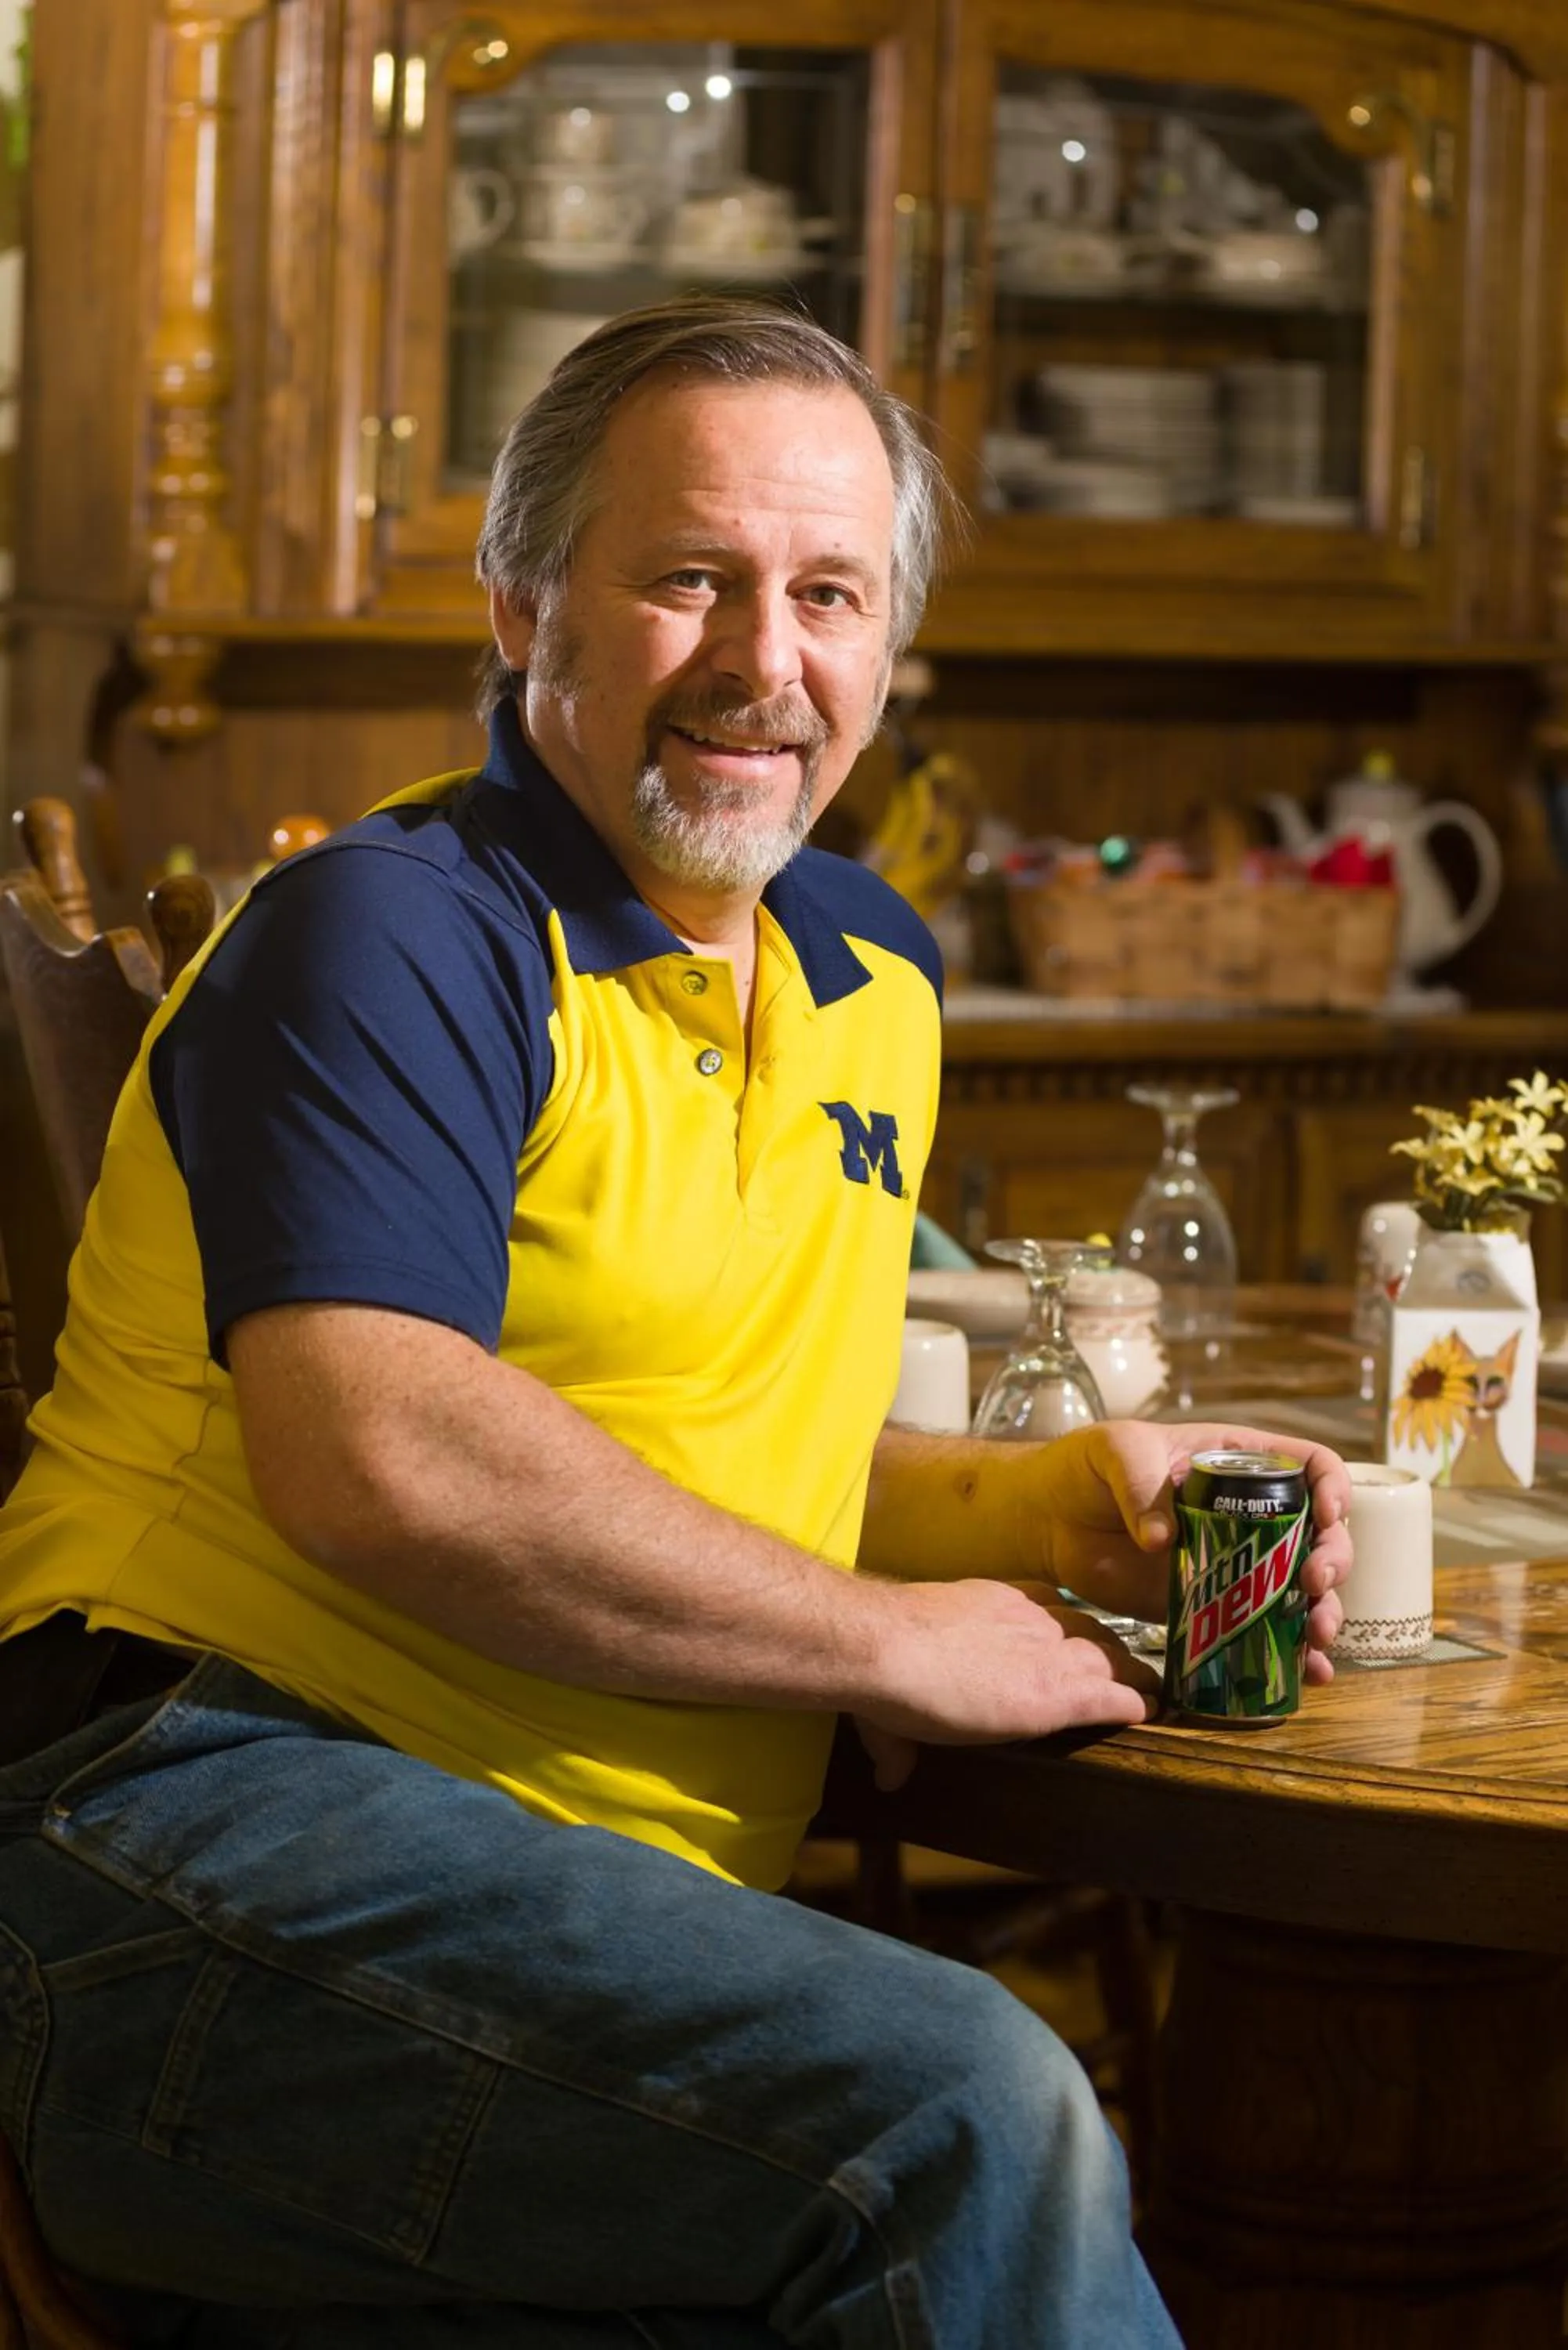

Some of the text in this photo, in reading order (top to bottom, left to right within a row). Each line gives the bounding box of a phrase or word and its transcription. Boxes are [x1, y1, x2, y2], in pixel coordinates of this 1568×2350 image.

[817, 1101, 902, 1198] M
[1213, 1495, 1281, 1513] CALL DUTY
